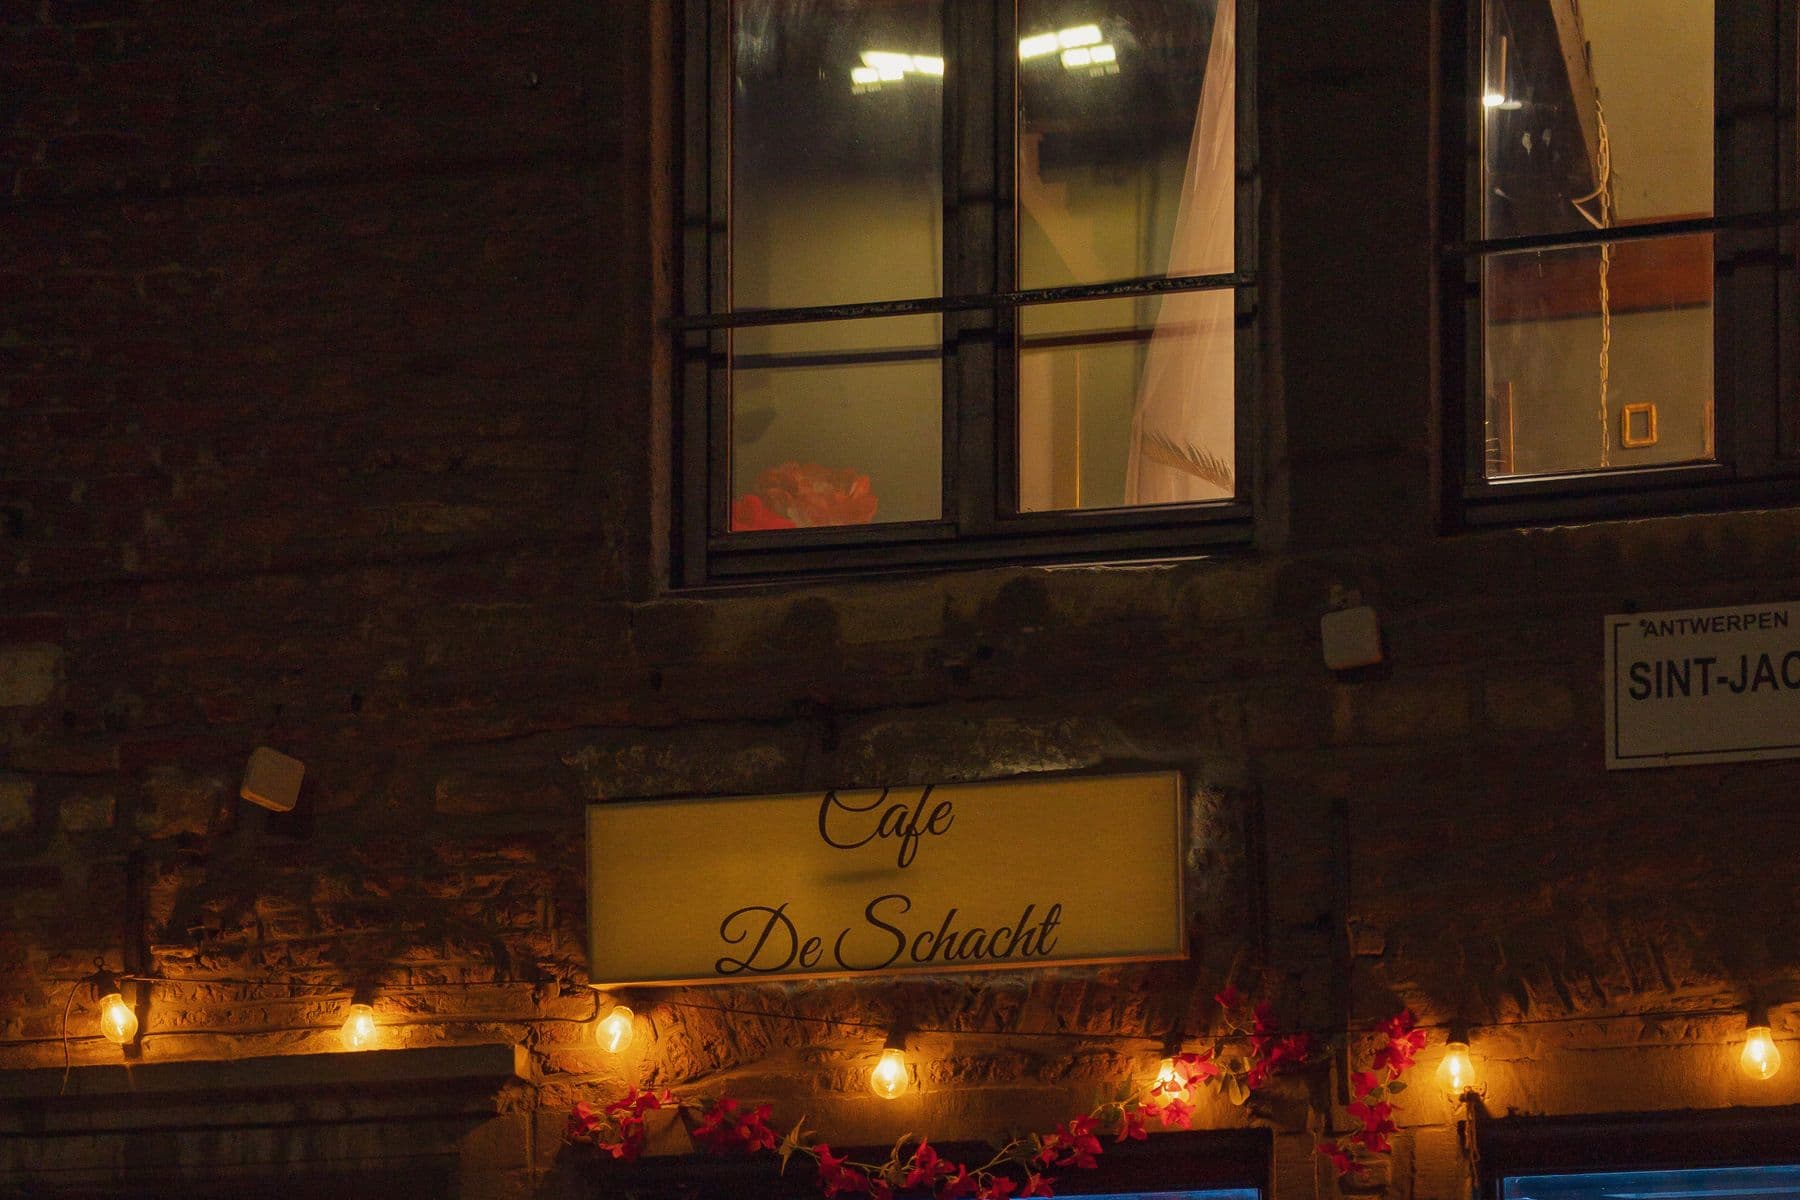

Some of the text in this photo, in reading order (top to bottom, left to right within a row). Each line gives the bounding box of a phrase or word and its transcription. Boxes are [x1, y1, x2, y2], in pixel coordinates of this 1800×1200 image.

[1641, 610, 1788, 638] ANTWERPEN
[818, 784, 954, 868] Cafe
[714, 893, 1063, 975] De Schacht
